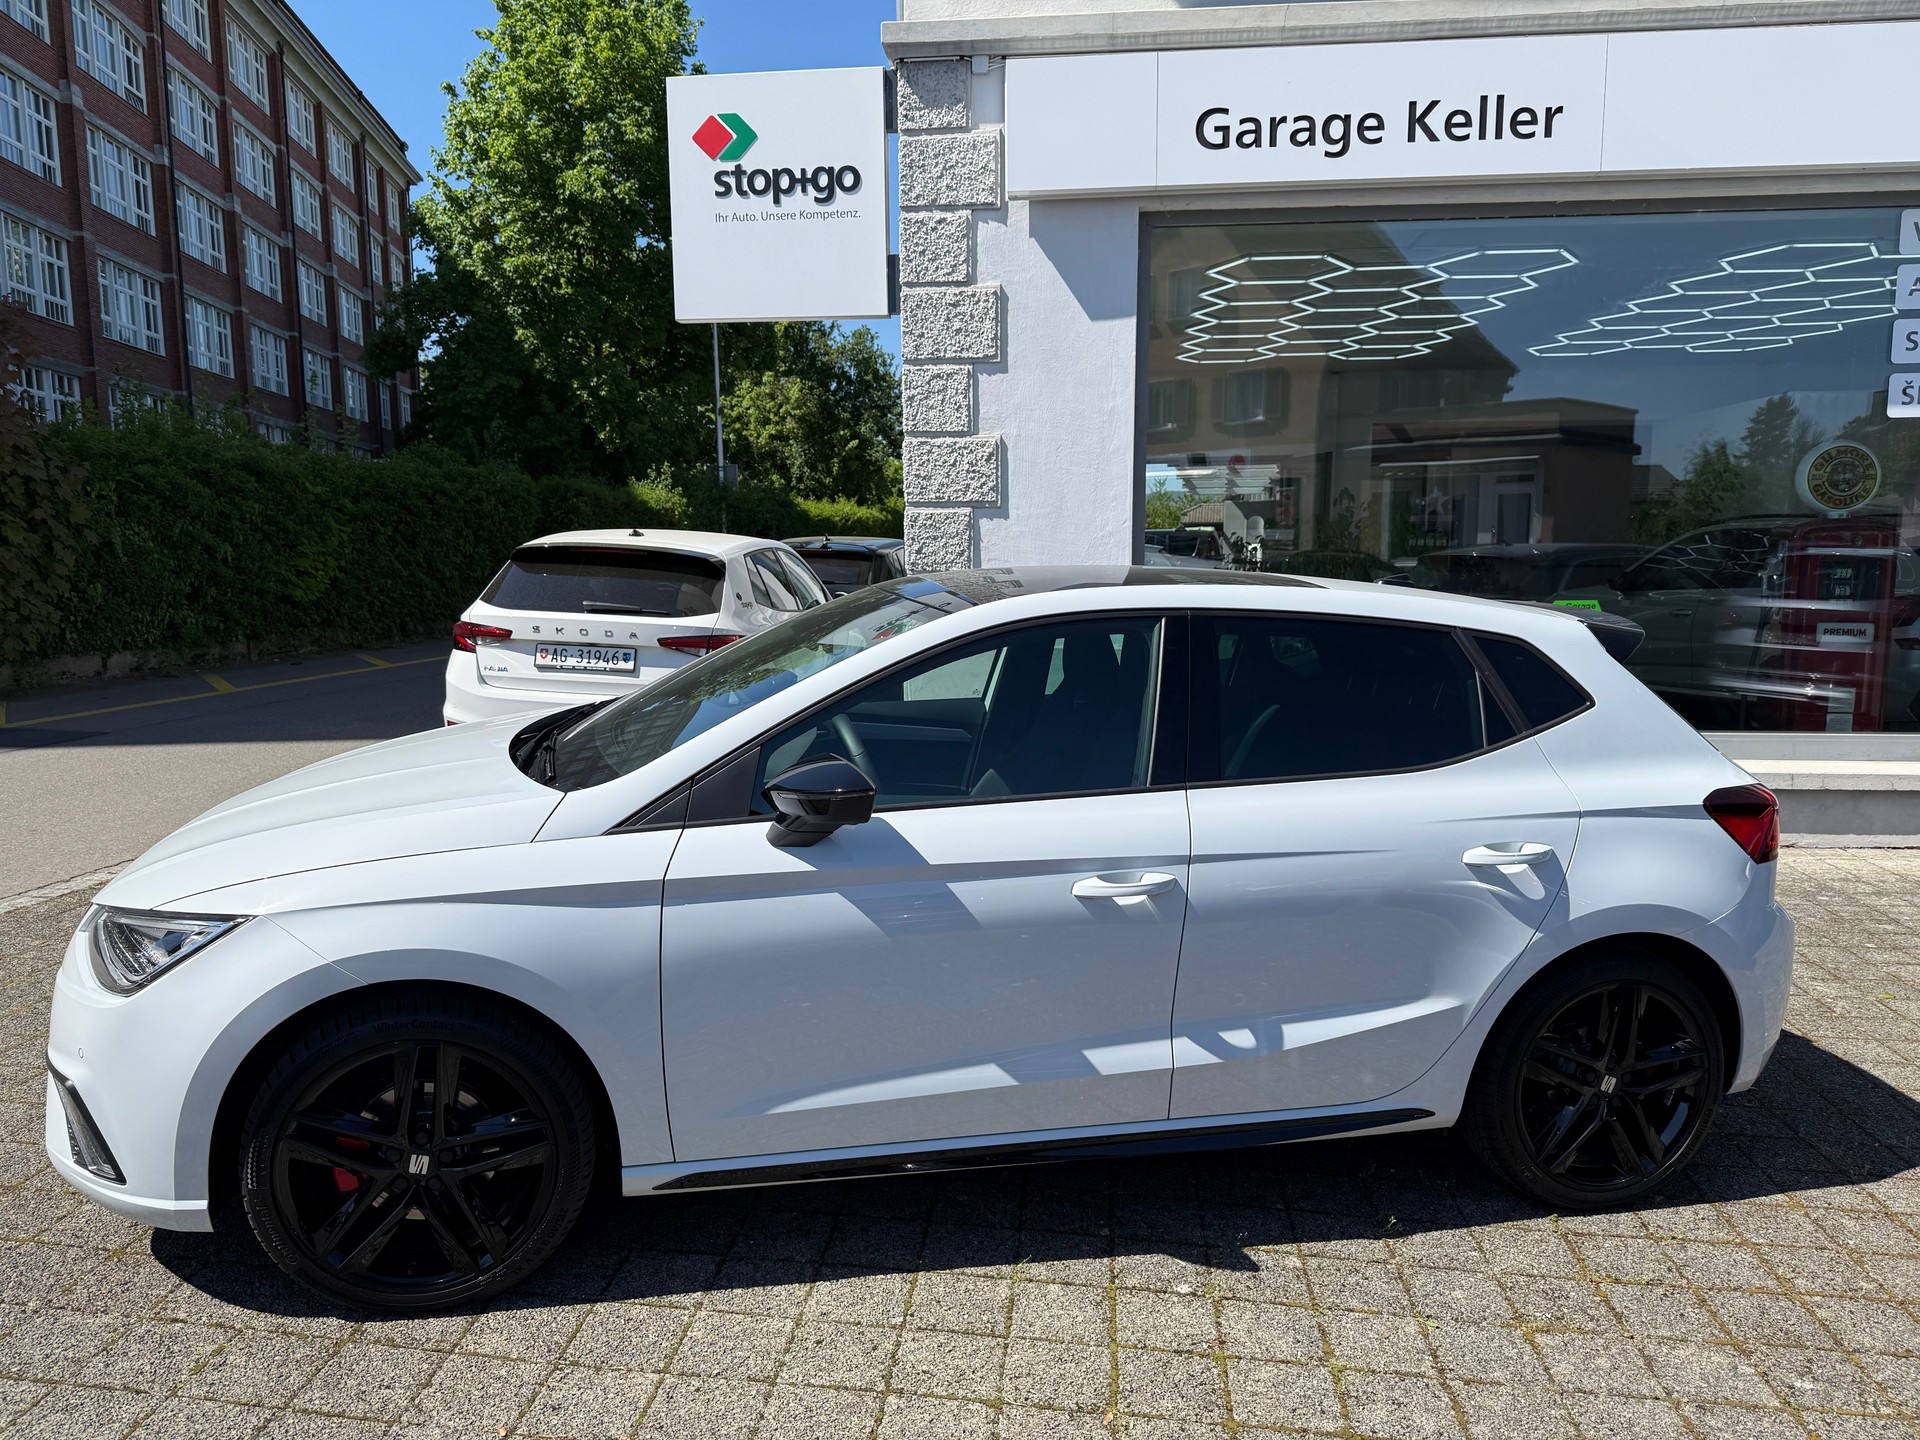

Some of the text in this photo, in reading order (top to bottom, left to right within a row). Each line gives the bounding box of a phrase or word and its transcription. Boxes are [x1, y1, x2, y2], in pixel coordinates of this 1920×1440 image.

[1195, 94, 1564, 158] Garage Keller
[713, 163, 862, 206] stop+go
[714, 208, 861, 223] Ihr Auto. Unsere Kompetenz.
[1812, 483, 1872, 507] GASOLINE
[1823, 628, 1867, 638] PREMIUM
[255, 1205, 300, 1265] Continental
